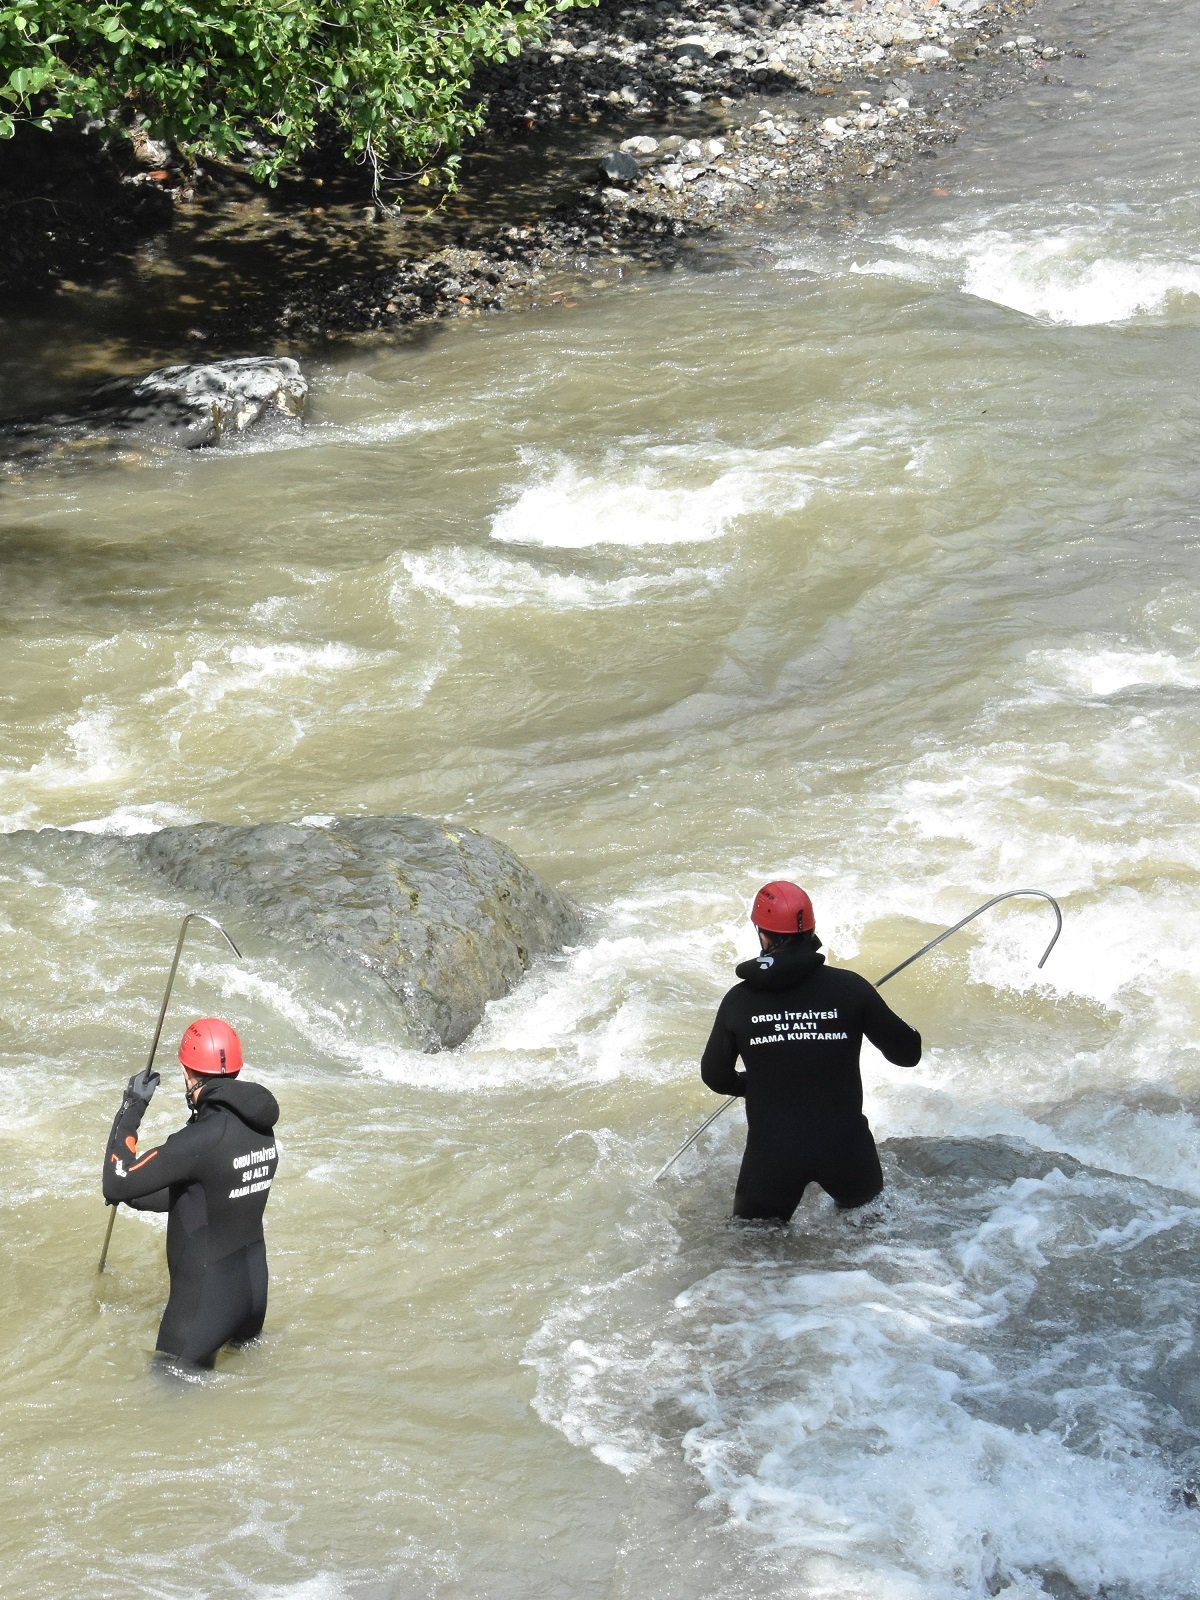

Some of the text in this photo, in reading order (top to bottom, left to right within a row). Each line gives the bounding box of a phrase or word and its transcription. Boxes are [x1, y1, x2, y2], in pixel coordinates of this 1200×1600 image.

[751, 1008, 838, 1023] ORDU İTFAİYESİ
[774, 1022, 817, 1031] SU ALTI
[750, 1032, 848, 1045] ARAMA KURTARMA
[233, 1154, 251, 1169] ORDU
[242, 1166, 269, 1182] SU ALTI
